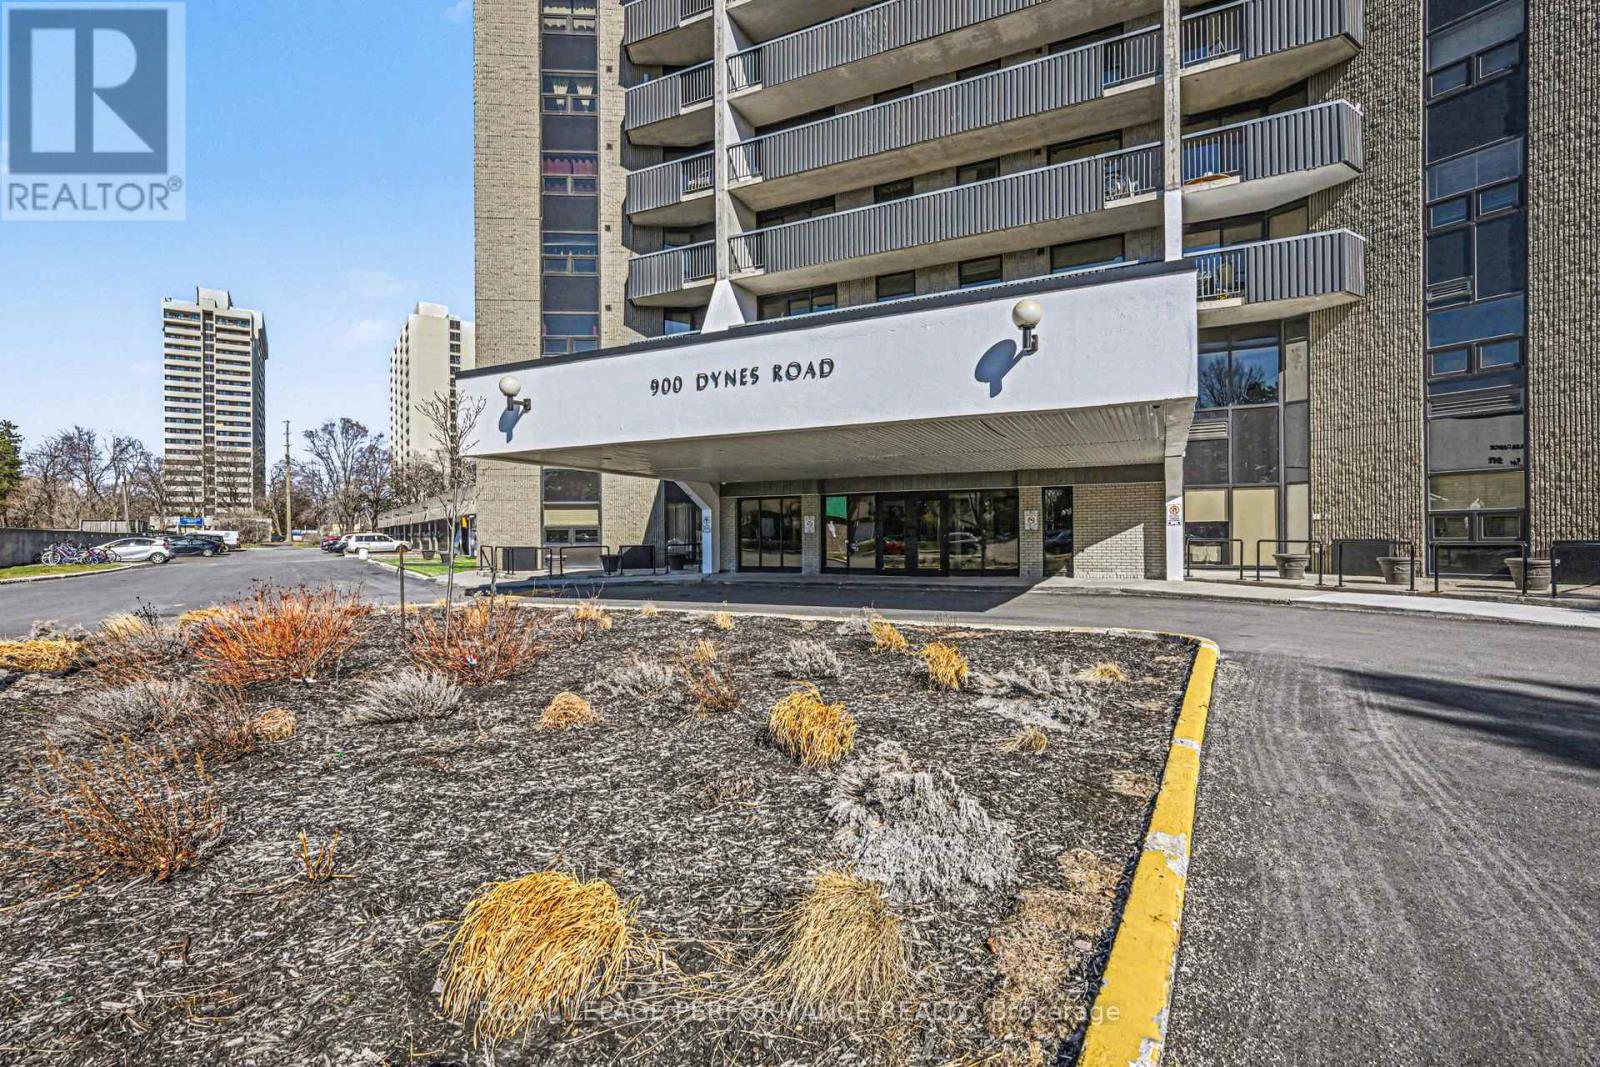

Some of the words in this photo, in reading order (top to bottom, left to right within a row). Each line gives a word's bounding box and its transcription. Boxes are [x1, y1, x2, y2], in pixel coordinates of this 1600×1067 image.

[650, 376, 683, 396] 900
[696, 366, 760, 392] DYNES
[773, 358, 835, 382] ROAD
